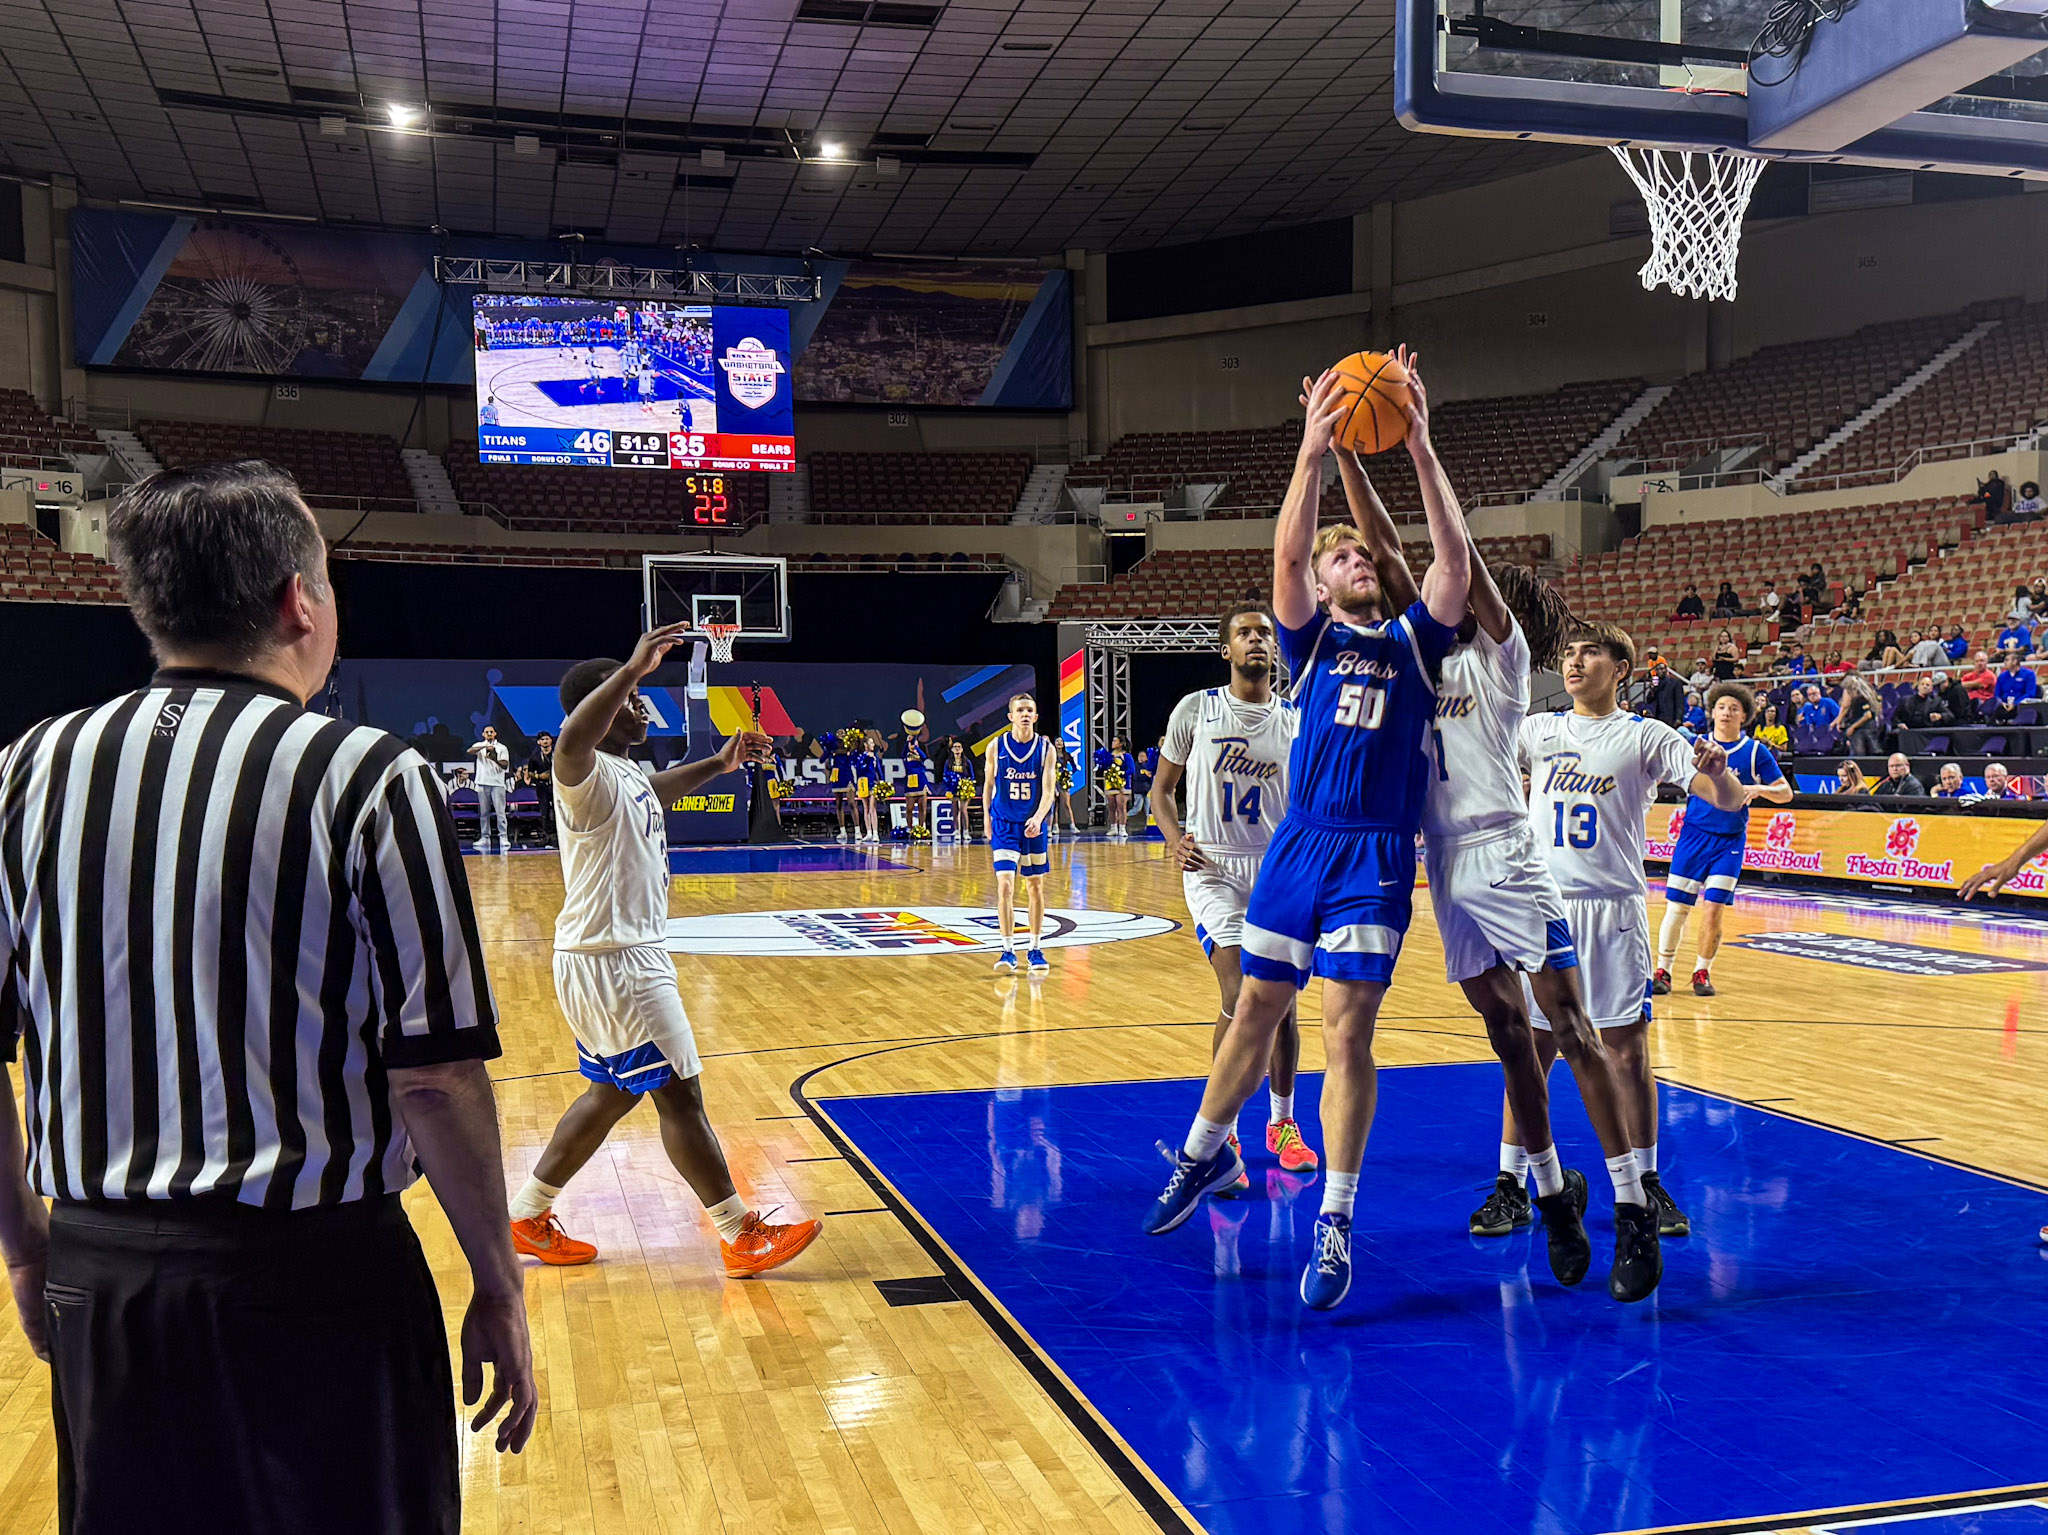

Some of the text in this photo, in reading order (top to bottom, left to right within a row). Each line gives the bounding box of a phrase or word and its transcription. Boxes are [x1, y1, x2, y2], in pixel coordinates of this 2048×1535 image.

[724, 361, 780, 370] BASKETBALL
[1221, 357, 1239, 369] 303
[732, 373, 773, 383] STATE
[277, 385, 297, 398] 336
[889, 412, 907, 425] 302
[483, 435, 526, 446] TITANS
[574, 431, 610, 453] 46
[620, 435, 661, 450] 51.9
[670, 434, 705, 456] 35
[752, 443, 791, 455] BEARS
[631, 455, 639, 464] 4
[55, 480, 73, 494] 16
[686, 477, 723, 493] 51.8
[694, 495, 727, 522] 22
[1329, 651, 1399, 679] Bears
[1334, 684, 1385, 729] 50
[1211, 737, 1278, 779] Titans
[1004, 767, 1037, 780] Bears
[1543, 752, 1616, 795] Titans
[1010, 782, 1031, 800] 55
[671, 795, 731, 811] LERNER ROWE
[1222, 781, 1261, 825] 14
[1553, 801, 1598, 849] 13
[1780, 850, 1820, 869] Bowl
[1847, 855, 1950, 880] Fiesta Bowl
